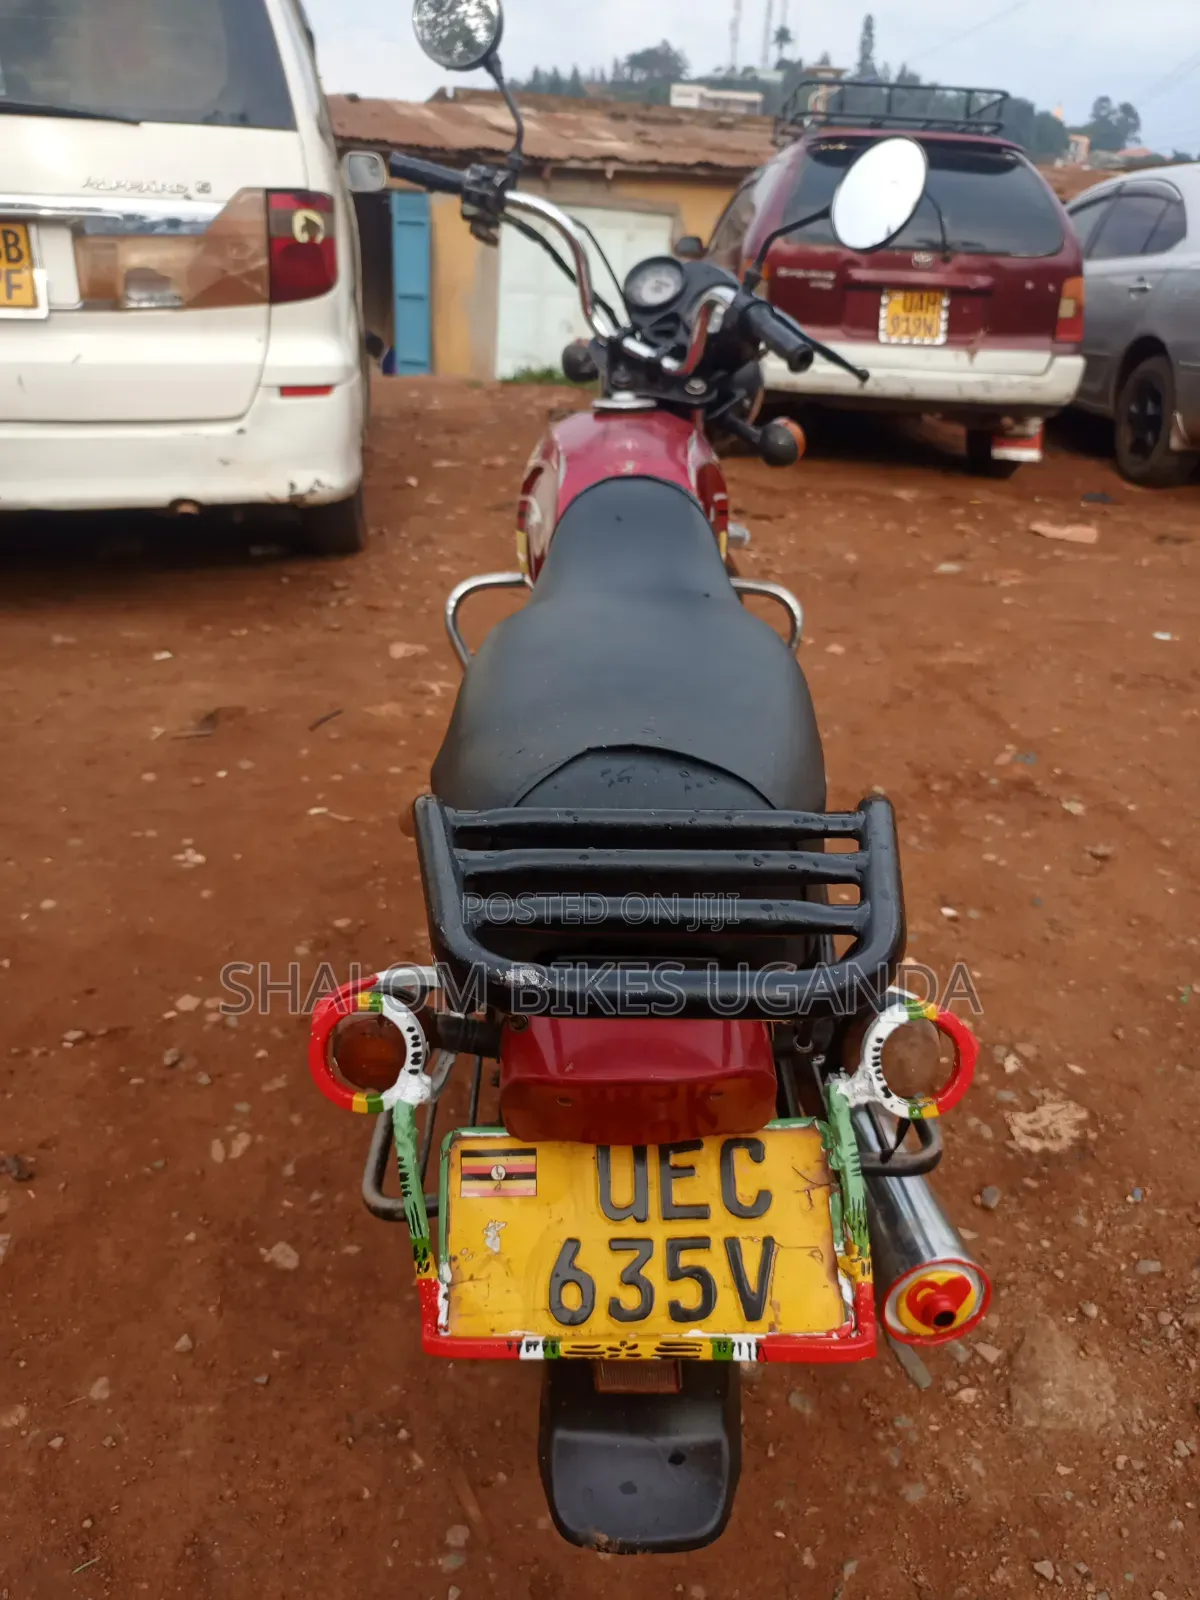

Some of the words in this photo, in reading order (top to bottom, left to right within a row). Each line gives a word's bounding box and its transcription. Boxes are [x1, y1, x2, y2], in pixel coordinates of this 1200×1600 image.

[0, 229, 24, 264] B
[0, 269, 24, 300] F
[596, 1137, 773, 1223] UEC
[548, 1235, 776, 1327] 635V
